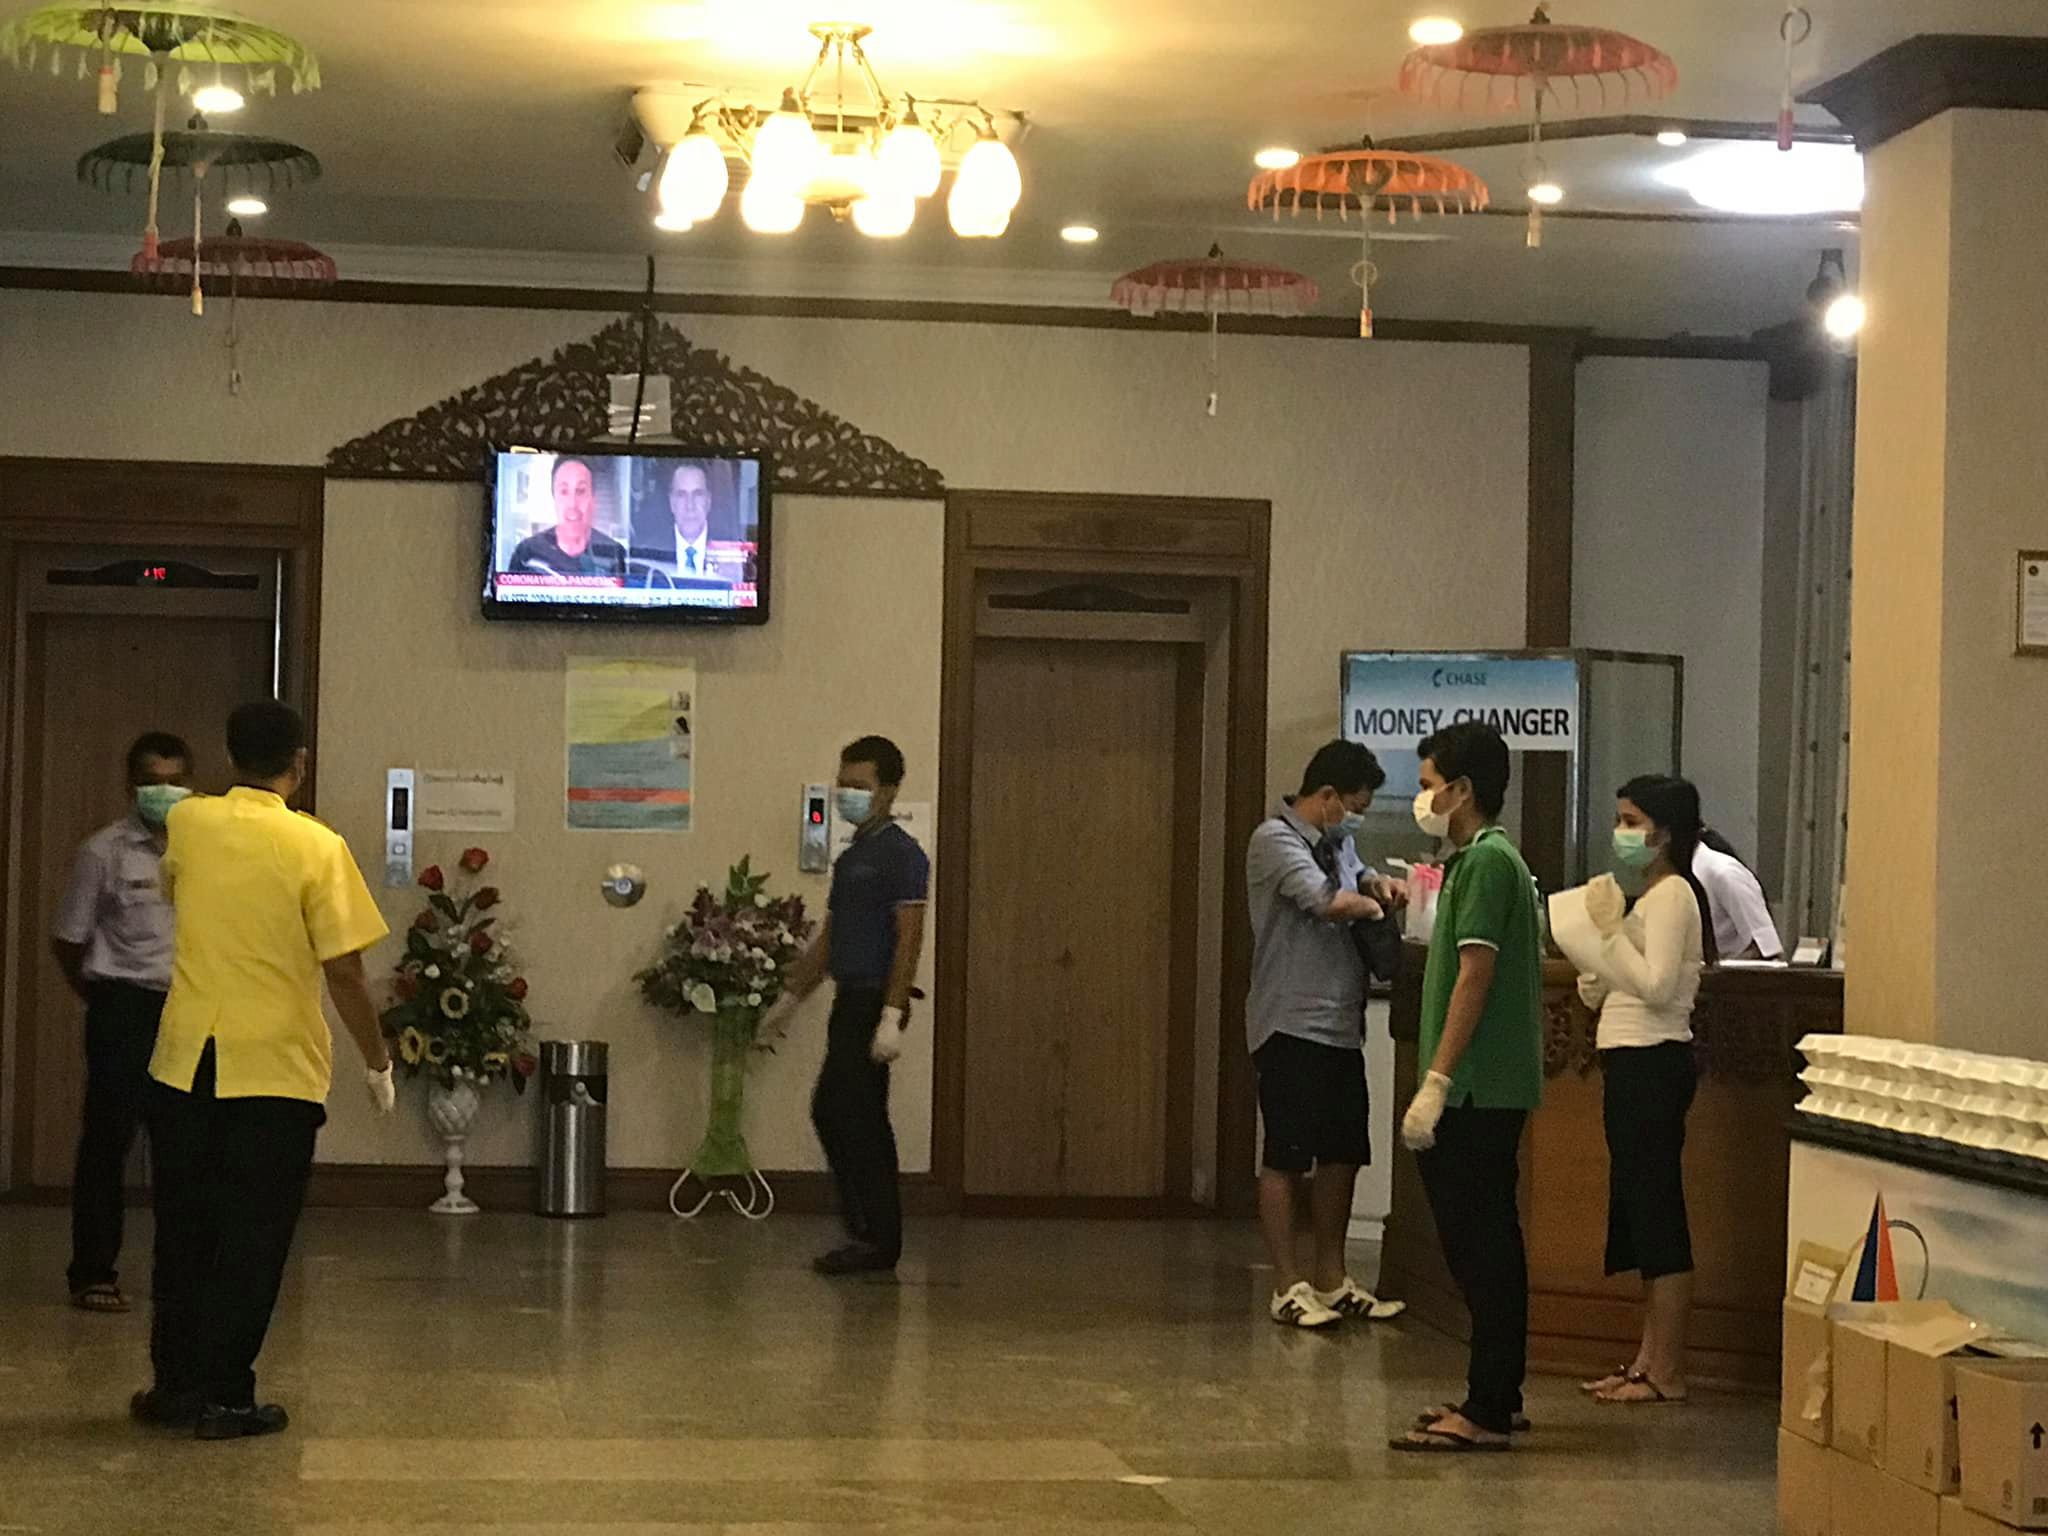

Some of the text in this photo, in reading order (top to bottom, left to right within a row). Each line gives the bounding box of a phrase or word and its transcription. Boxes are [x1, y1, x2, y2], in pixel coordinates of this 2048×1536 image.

[1446, 672, 1487, 686] CHASE
[1354, 708, 1570, 736] MONEY CHANGER
